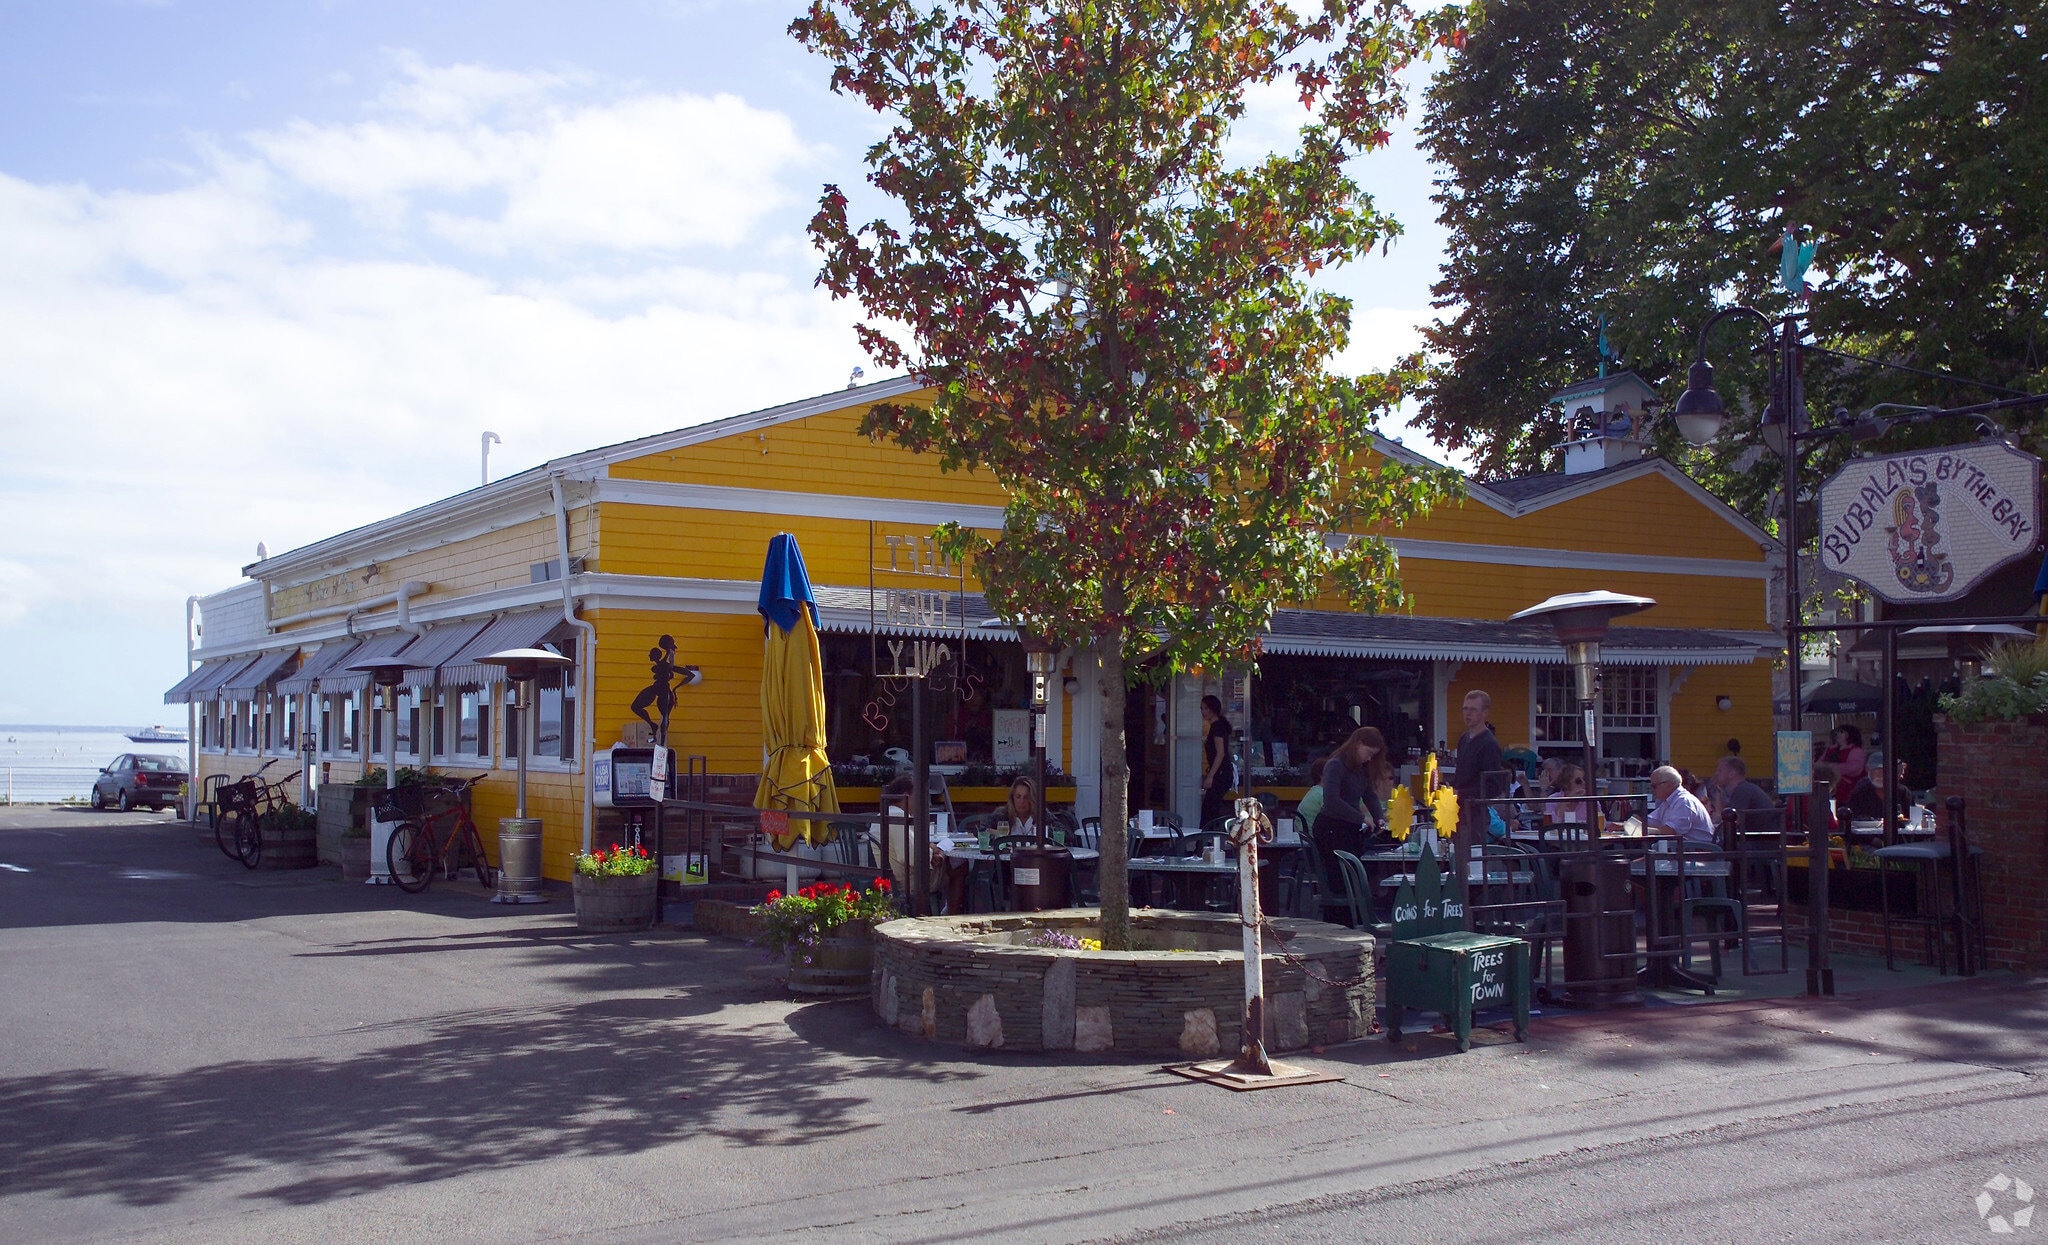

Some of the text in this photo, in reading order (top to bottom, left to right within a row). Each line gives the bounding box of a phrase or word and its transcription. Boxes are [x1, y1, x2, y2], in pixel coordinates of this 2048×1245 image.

[1824, 456, 2032, 565] BUBALA'S BY THE BAY
[595, 775, 610, 787] TODAY
[1423, 899, 1438, 919] for
[1470, 951, 1504, 973] TREES
[1482, 969, 1496, 984] for
[1470, 983, 1505, 1004] TOWN
